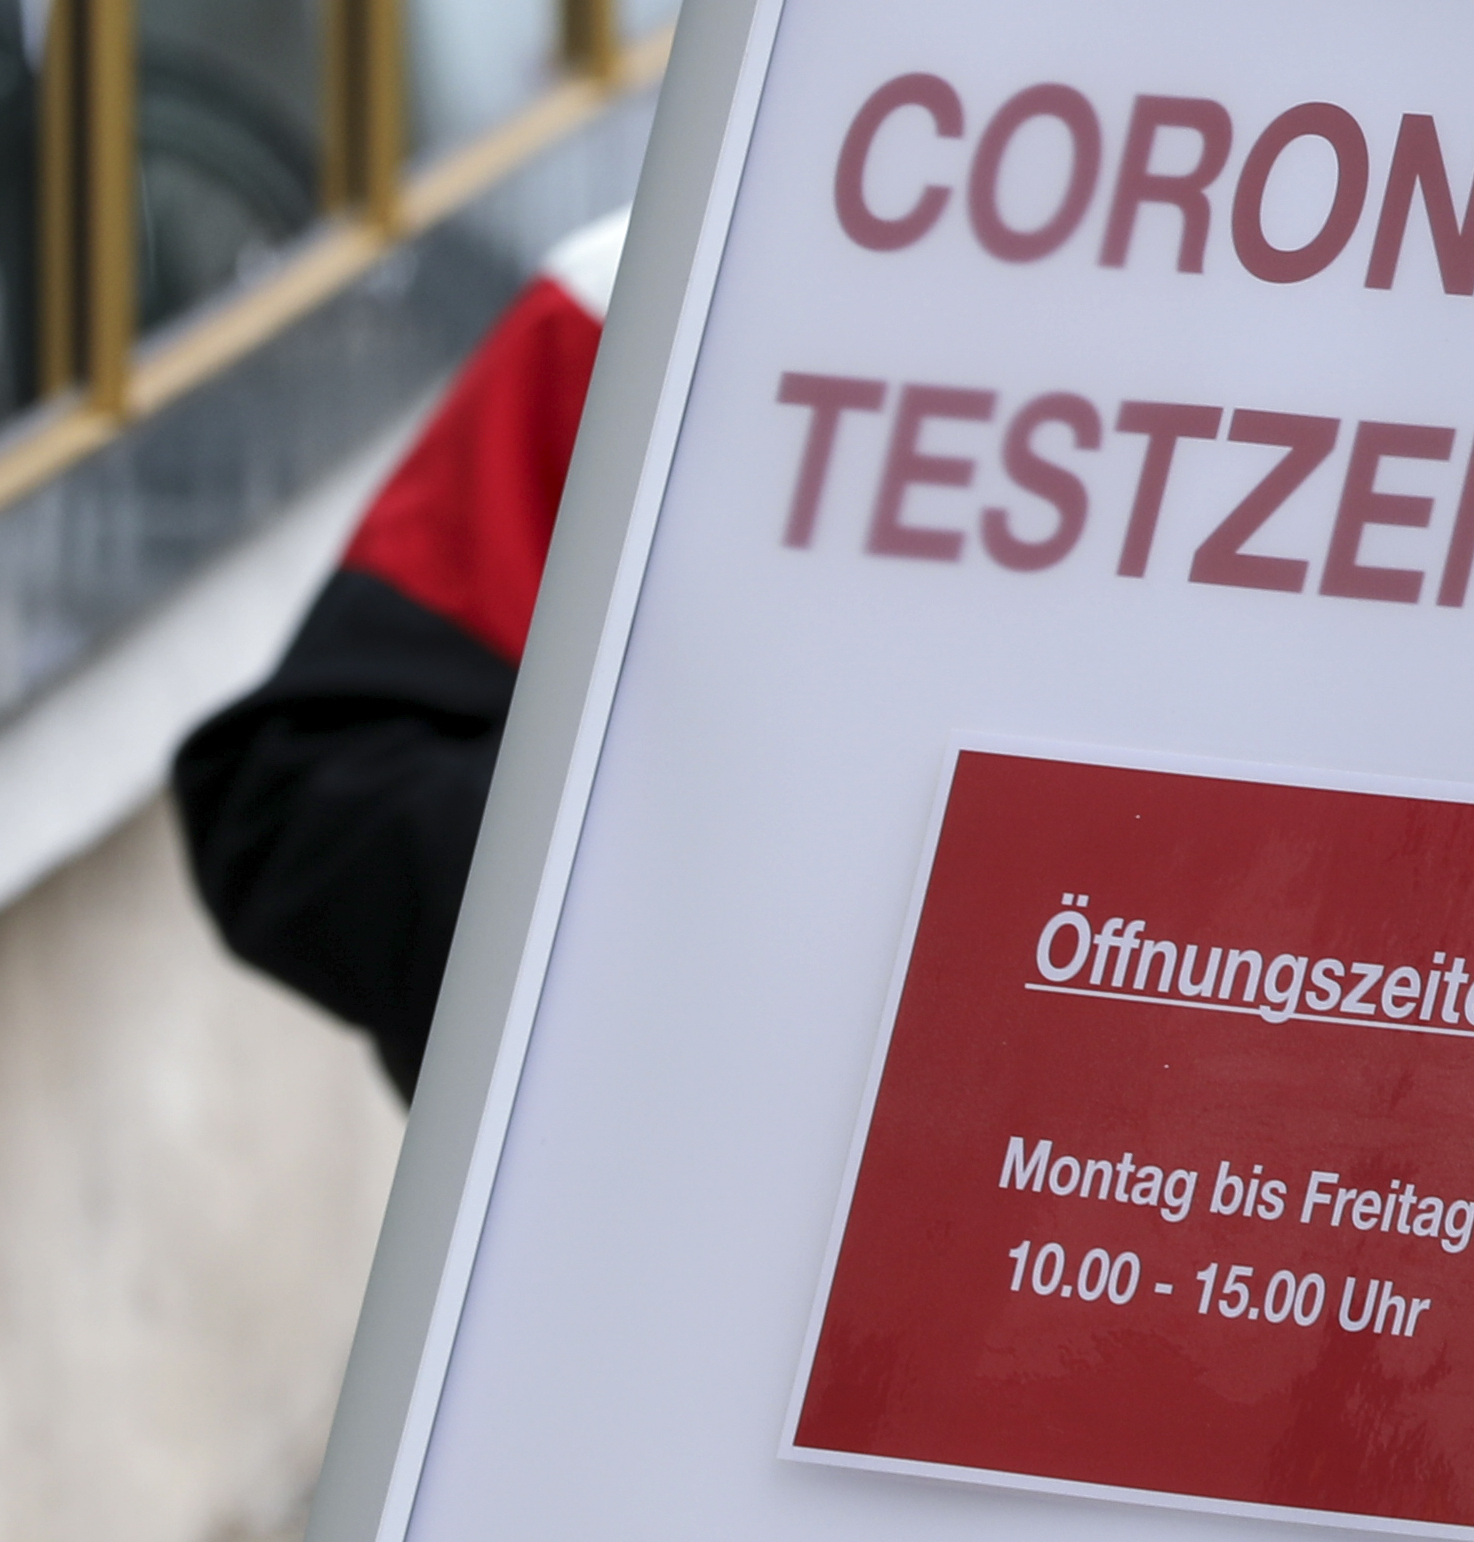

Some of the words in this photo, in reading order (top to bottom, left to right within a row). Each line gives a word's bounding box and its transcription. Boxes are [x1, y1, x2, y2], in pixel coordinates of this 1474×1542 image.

[998, 1136, 1198, 1223] Montag
[1209, 1160, 1287, 1220] bis
[1007, 1240, 1141, 1305] 10.00
[1154, 1282, 1173, 1295] -
[1195, 1262, 1326, 1327] 15.00
[1338, 1277, 1432, 1339] Uhr
